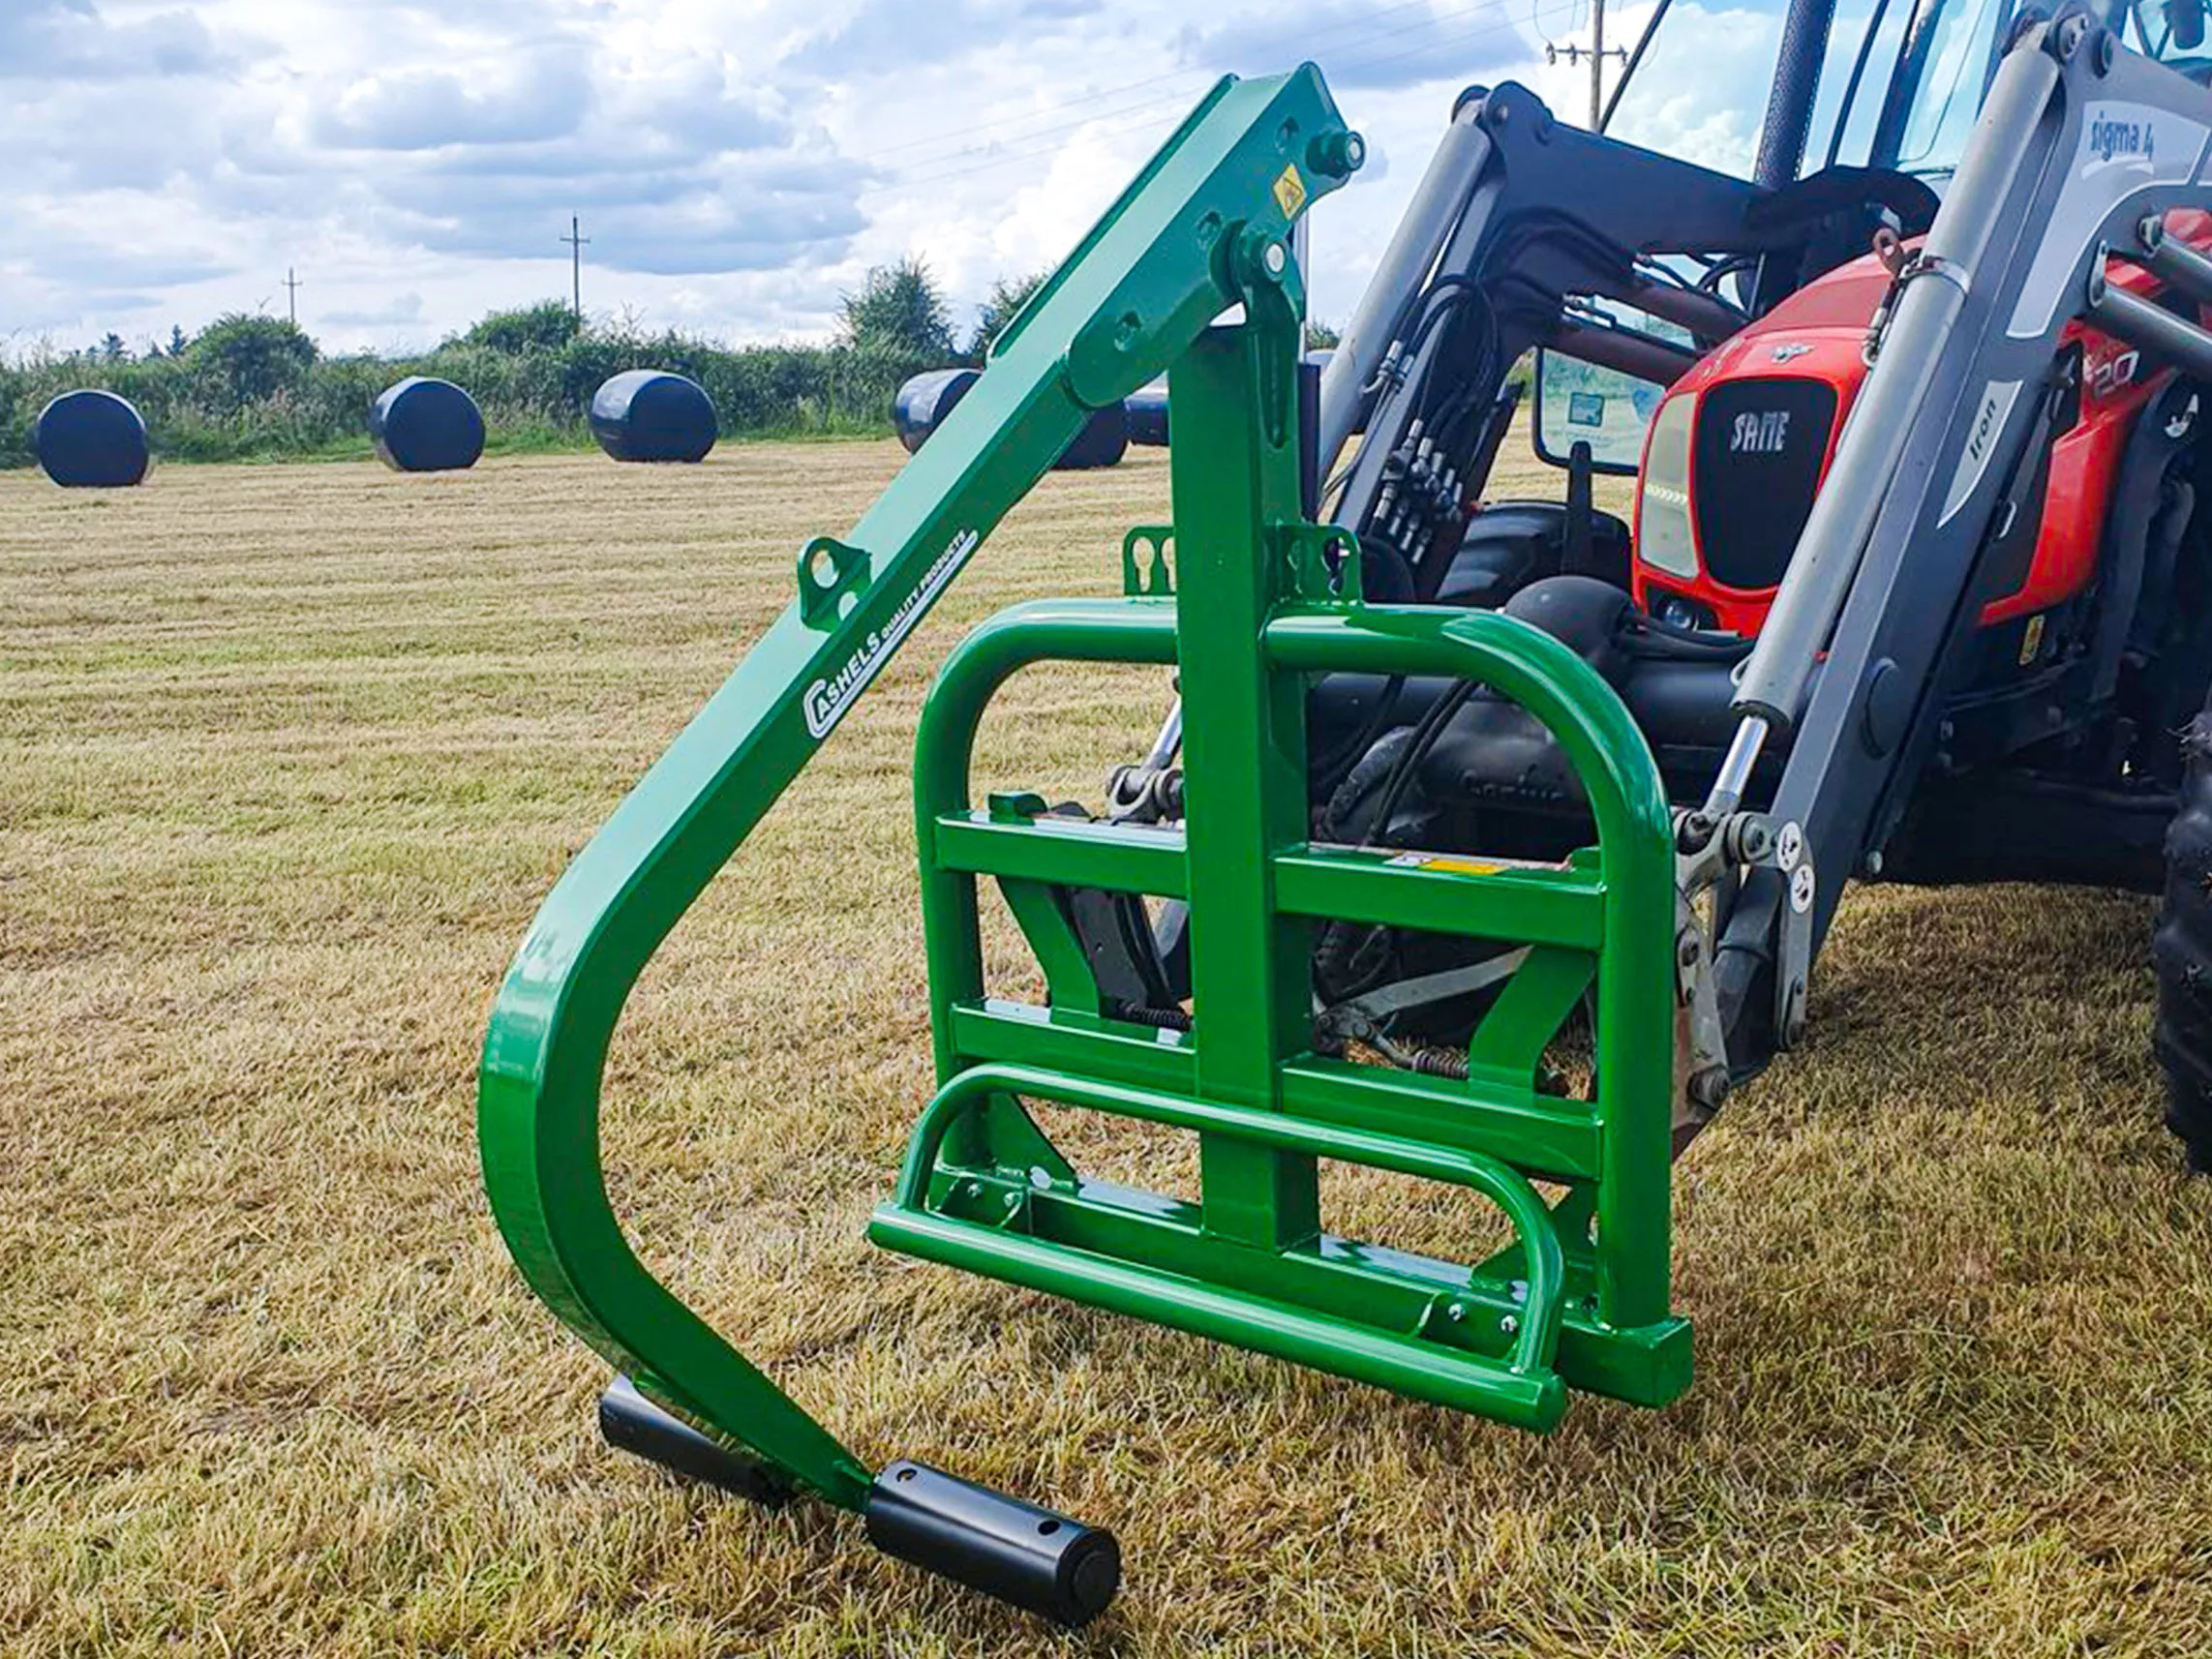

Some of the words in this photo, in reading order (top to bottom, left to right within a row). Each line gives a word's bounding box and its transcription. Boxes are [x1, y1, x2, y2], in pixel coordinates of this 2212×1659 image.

[2091, 109, 2139, 163] sigma
[2142, 123, 2154, 162] 4
[1731, 411, 1790, 452] SAME
[1969, 399, 1996, 461] Iron
[803, 631, 881, 739] CASHELS
[881, 588, 921, 640] QUALITY
[919, 529, 966, 590] PRODUCTS
